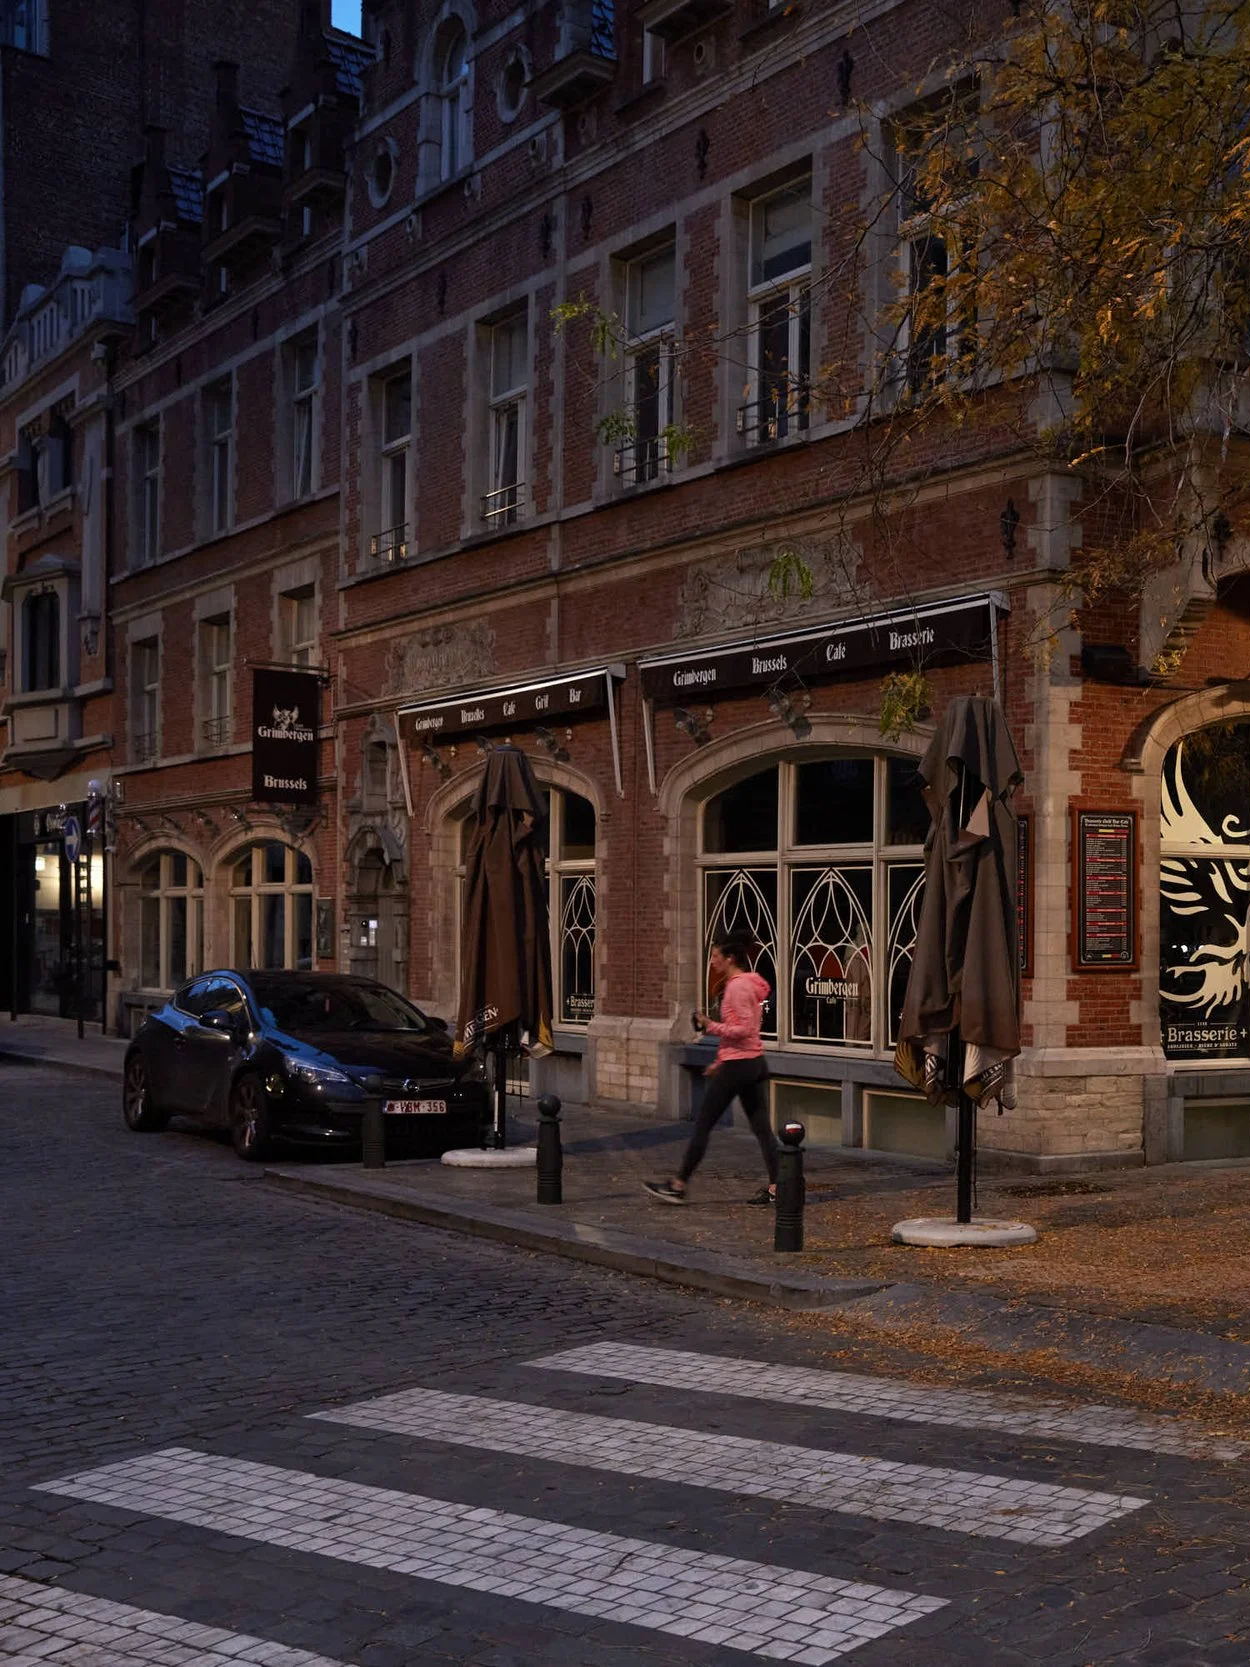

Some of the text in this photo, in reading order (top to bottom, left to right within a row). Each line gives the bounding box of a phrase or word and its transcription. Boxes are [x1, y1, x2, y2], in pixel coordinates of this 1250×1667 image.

[672, 666, 717, 688] Grimbergen
[751, 654, 787, 674] Brussels
[888, 626, 935, 651] Brasserie
[257, 725, 314, 744] Grimbergen
[263, 774, 308, 791] Brussels
[805, 976, 859, 998] Grimbergen
[1167, 1026, 1237, 1042] Brasserie
